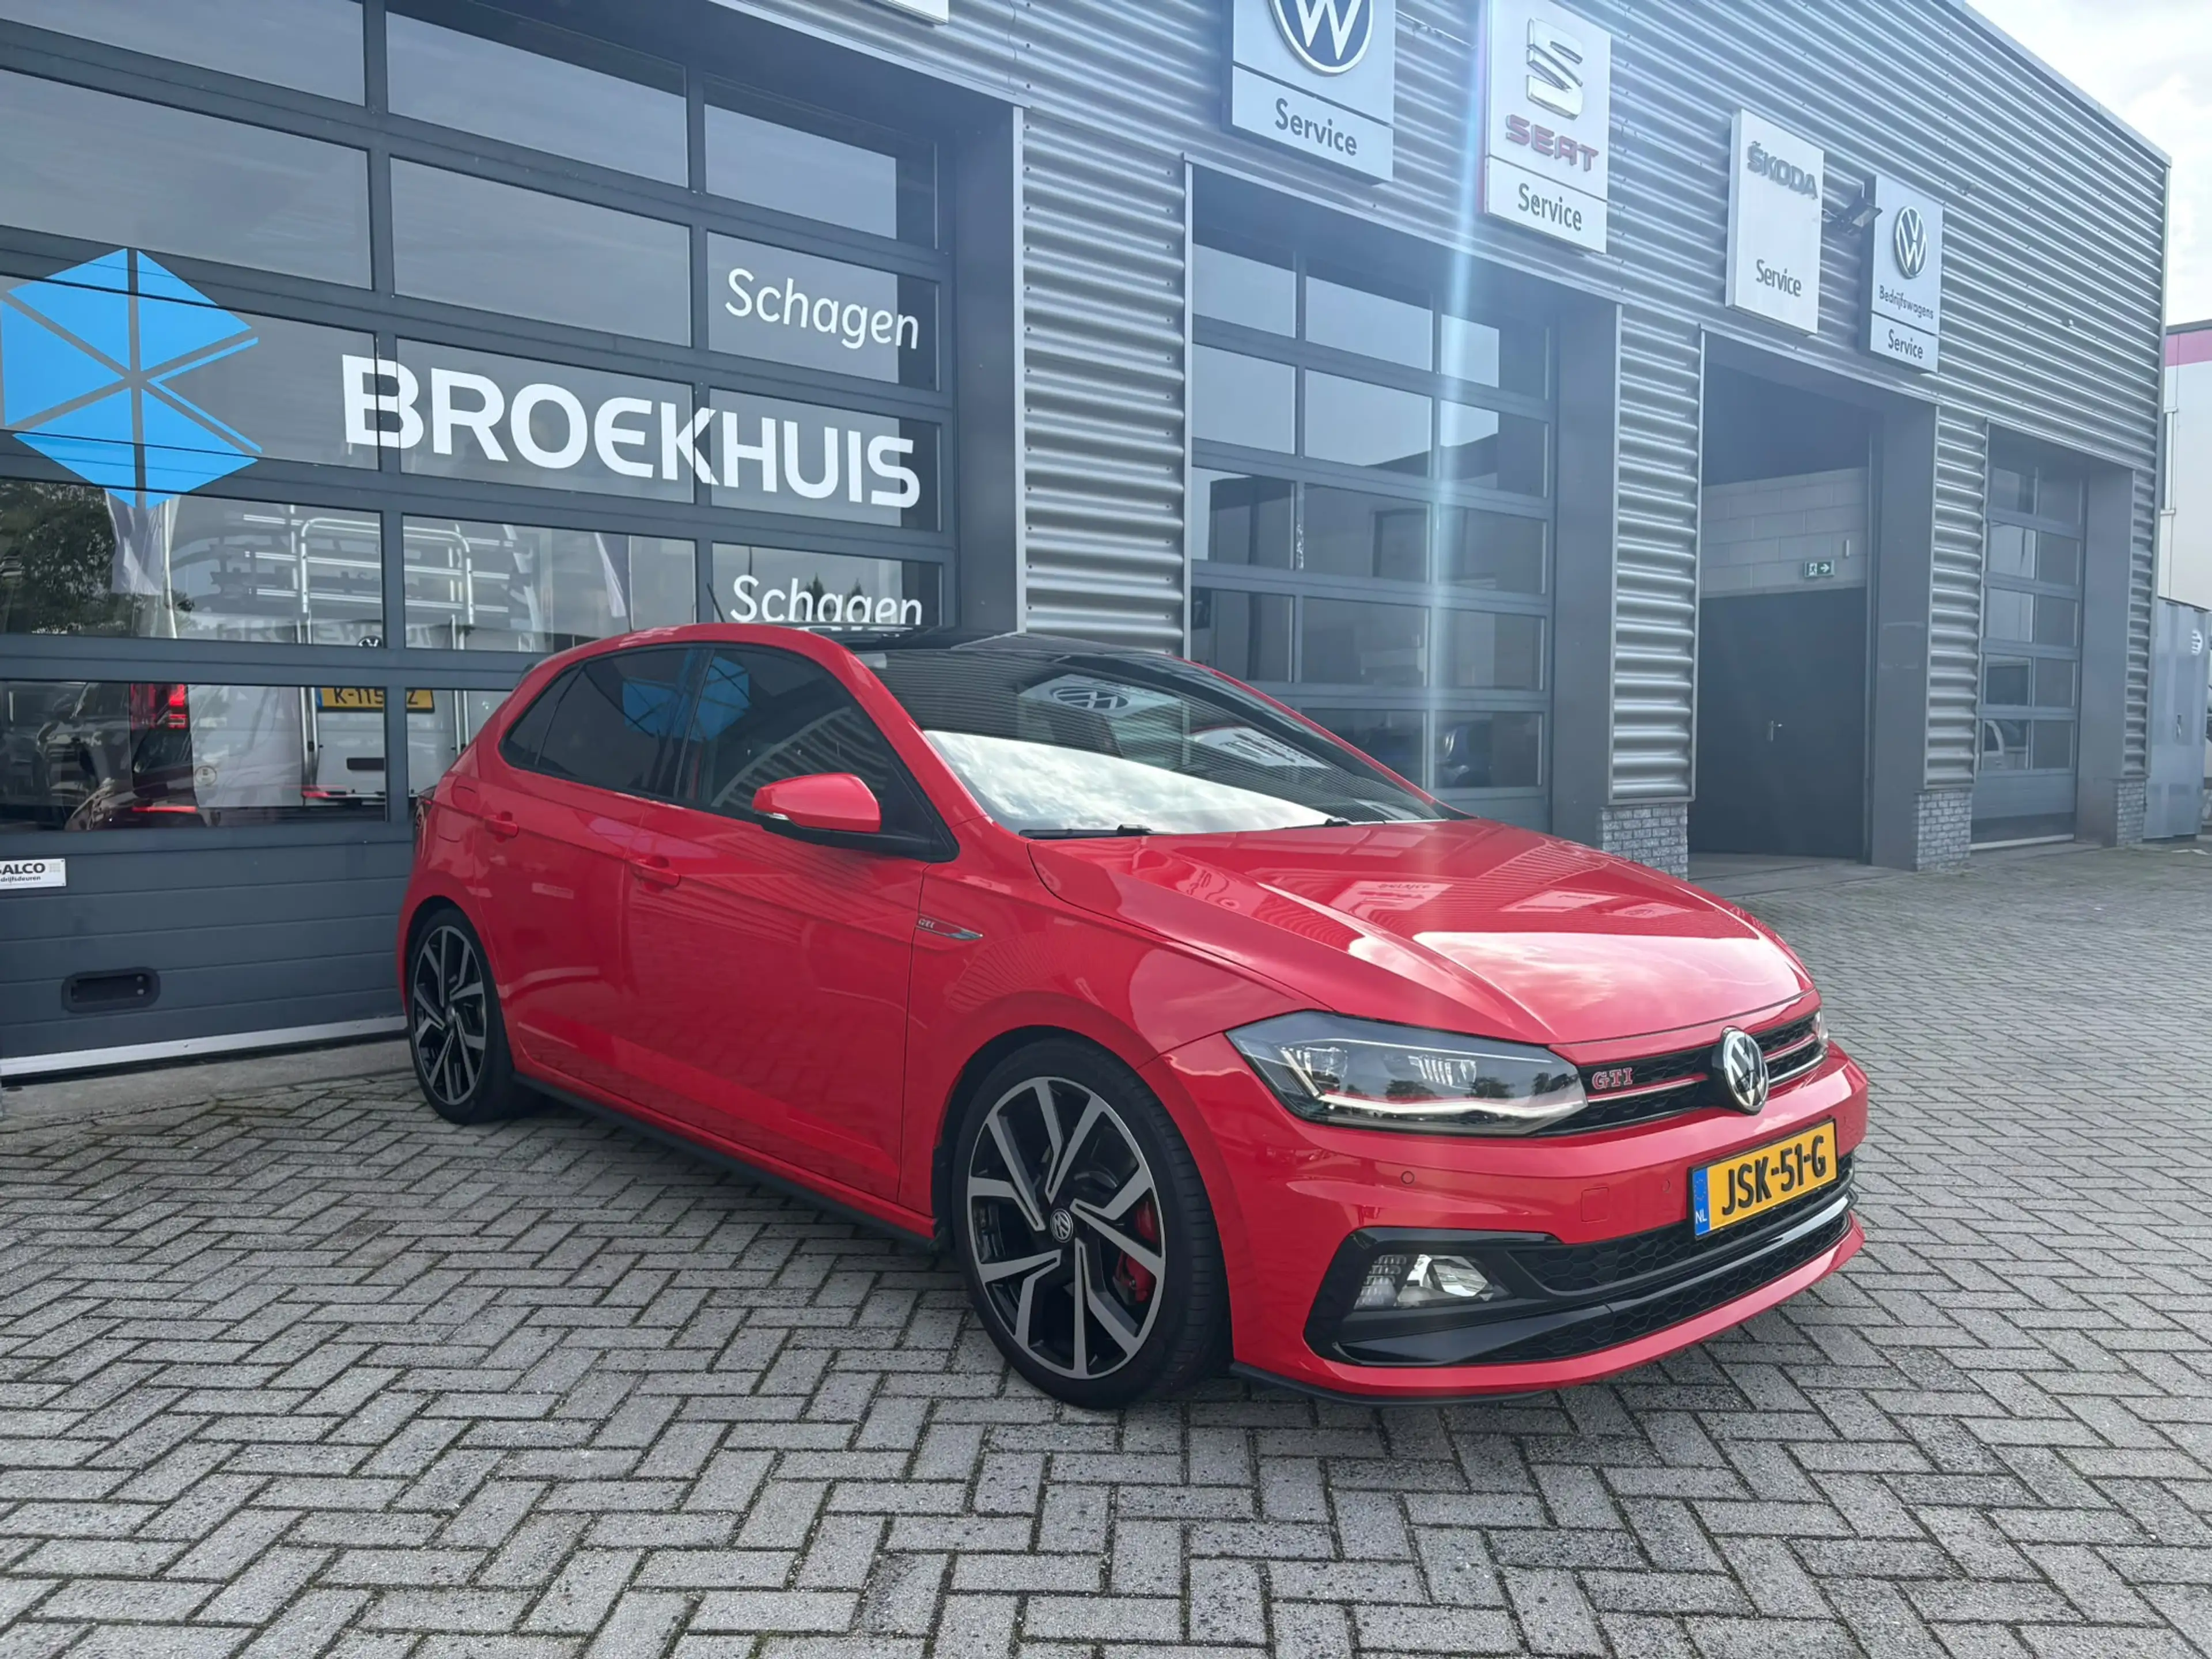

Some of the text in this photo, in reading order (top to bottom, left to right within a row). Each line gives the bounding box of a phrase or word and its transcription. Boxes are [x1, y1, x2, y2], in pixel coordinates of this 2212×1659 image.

[1275, 97, 1357, 156] Service
[1506, 114, 1599, 172] SEAT
[1747, 140, 1819, 200] ŠKODA
[1518, 183, 1582, 232] Service
[1756, 259, 1802, 297] Service
[1879, 285, 1934, 320] Bedrijfswagens
[725, 268, 919, 349] Schagen
[1888, 328, 1924, 359] Service
[342, 354, 921, 509] BROEKHUIS
[730, 575, 923, 626] Schagen
[0, 862, 46, 875] ALCO
[1592, 1067, 1633, 1090] GTI
[1722, 1135, 1827, 1217] JSK-51-G
[1695, 1207, 1708, 1225] NL
